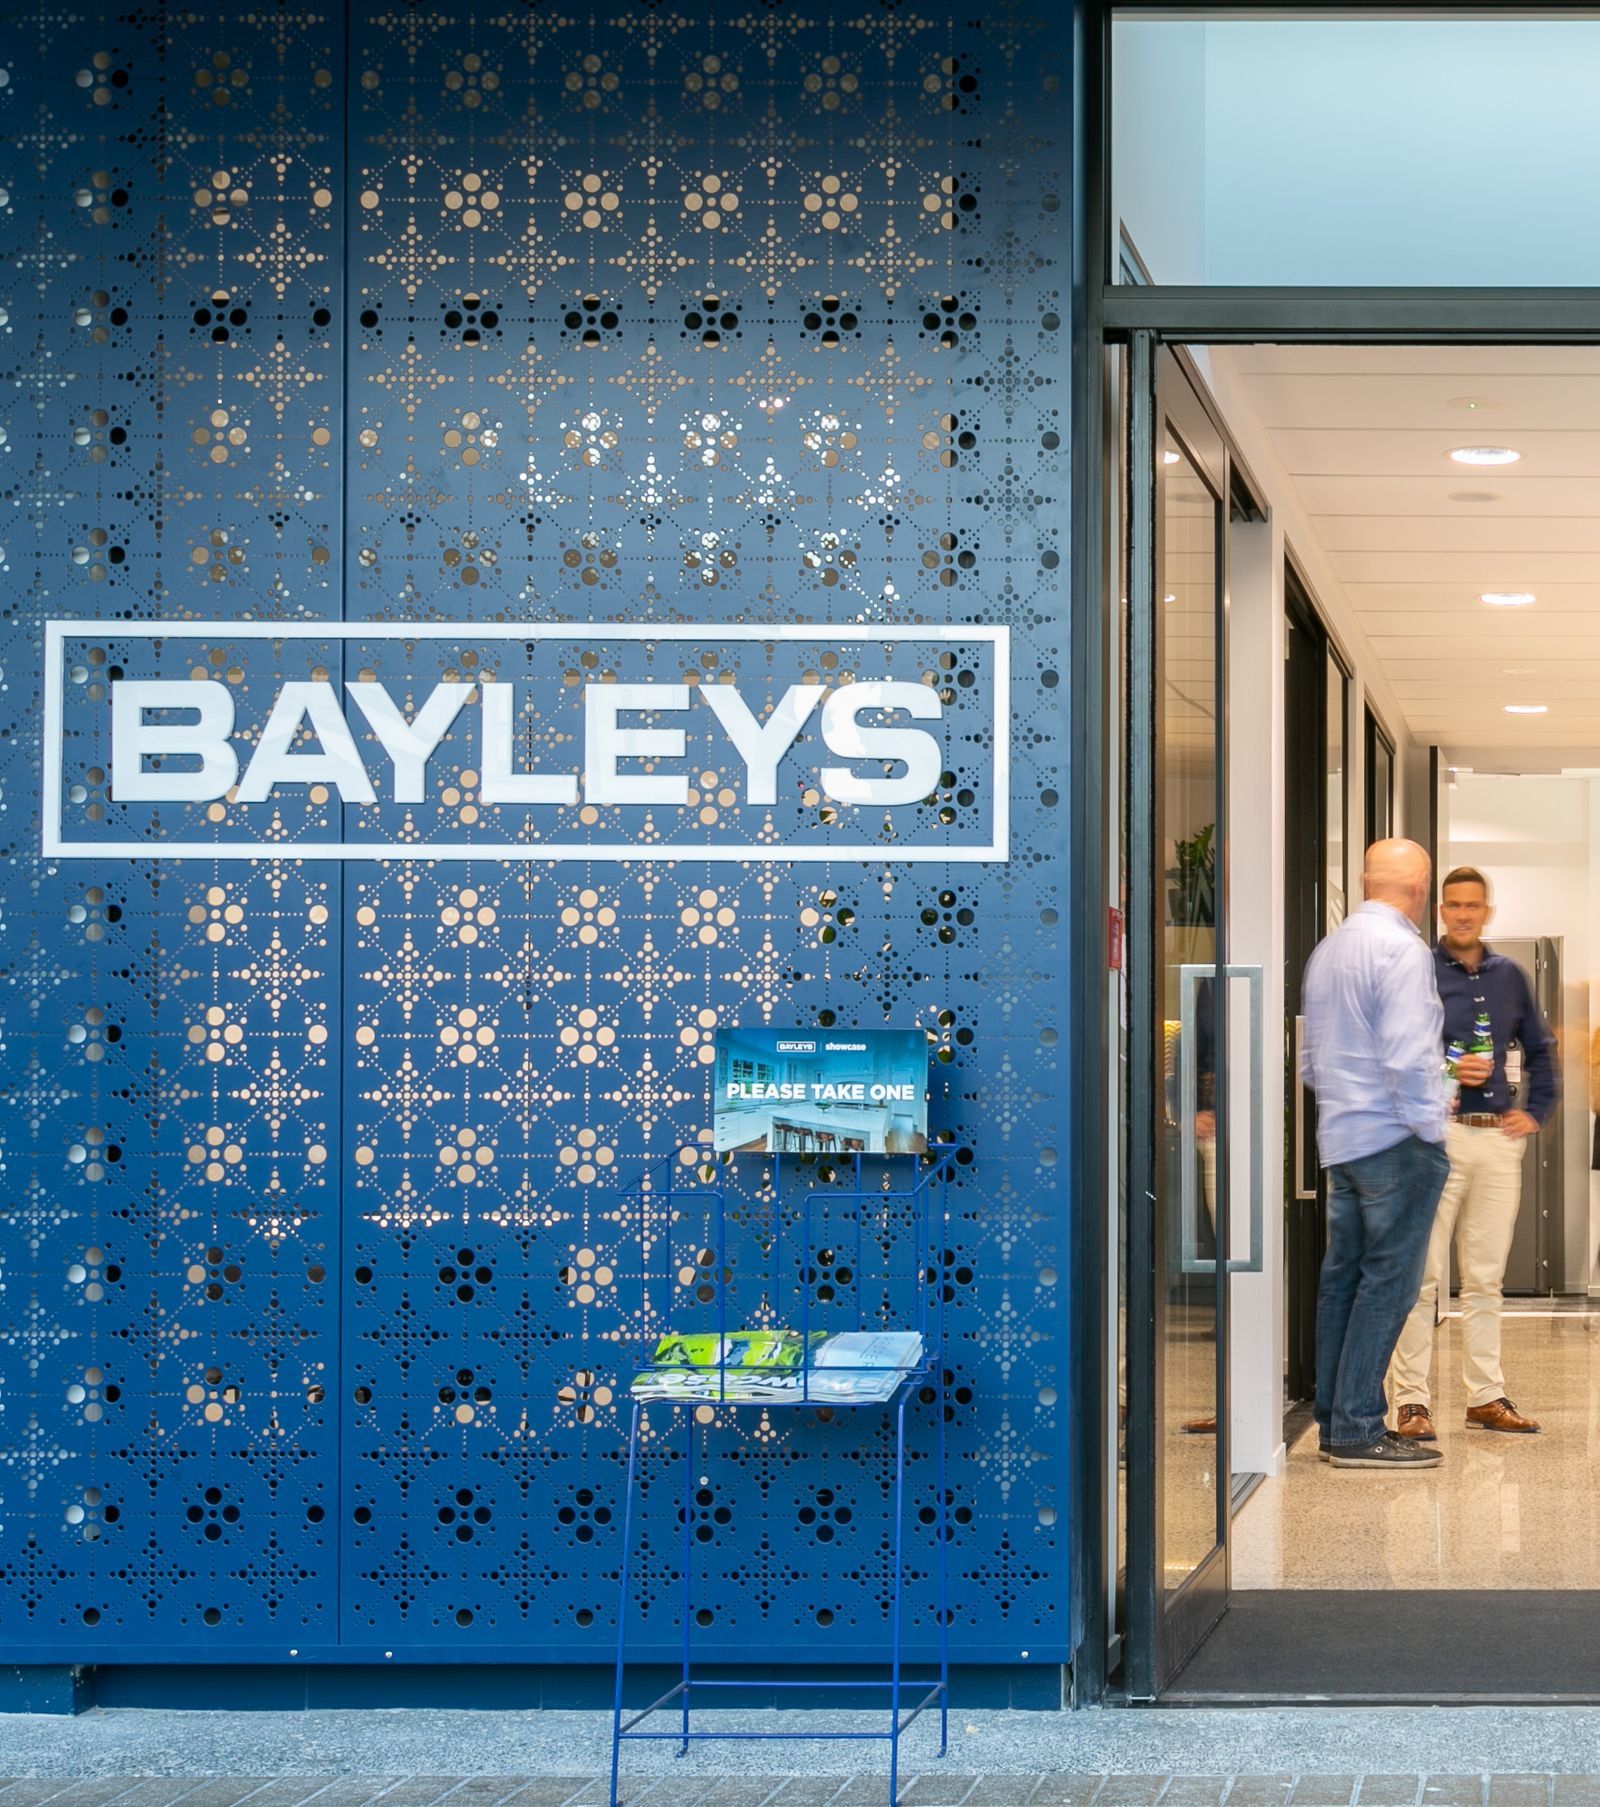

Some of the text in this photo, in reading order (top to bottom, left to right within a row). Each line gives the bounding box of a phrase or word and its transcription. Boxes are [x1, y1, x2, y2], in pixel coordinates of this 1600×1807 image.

[111, 679, 943, 807] BAYLEYS
[825, 1042, 867, 1051] showcase
[727, 1083, 915, 1100] PLEASE TAKE ONE
